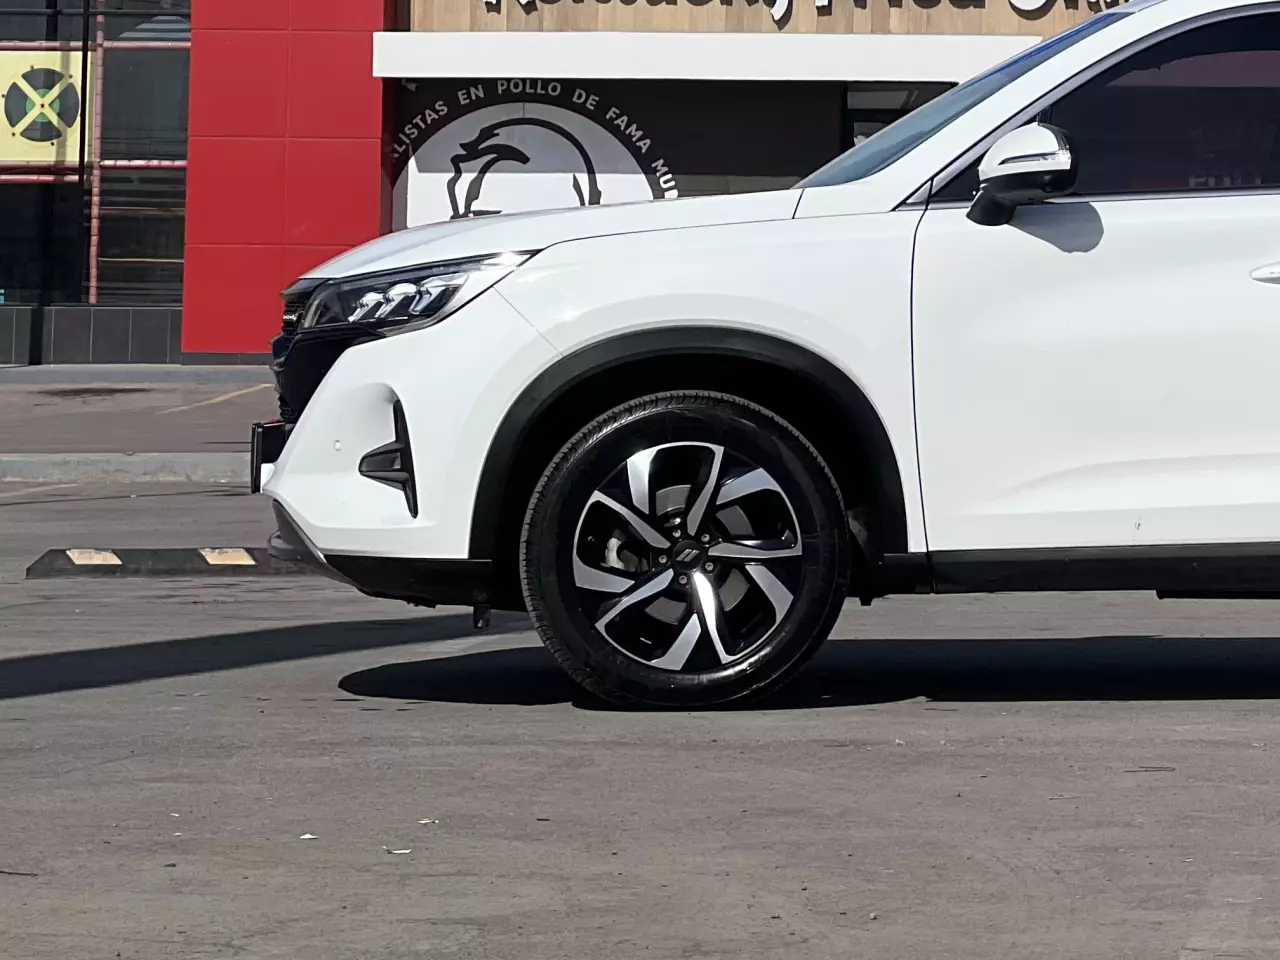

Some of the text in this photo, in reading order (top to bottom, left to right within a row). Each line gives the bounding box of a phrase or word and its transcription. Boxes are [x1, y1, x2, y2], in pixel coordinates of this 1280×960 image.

[457, 84, 485, 105] EN
[497, 79, 561, 96] POLLO
[572, 88, 600, 111] DE
[605, 106, 651, 153] FAMA
